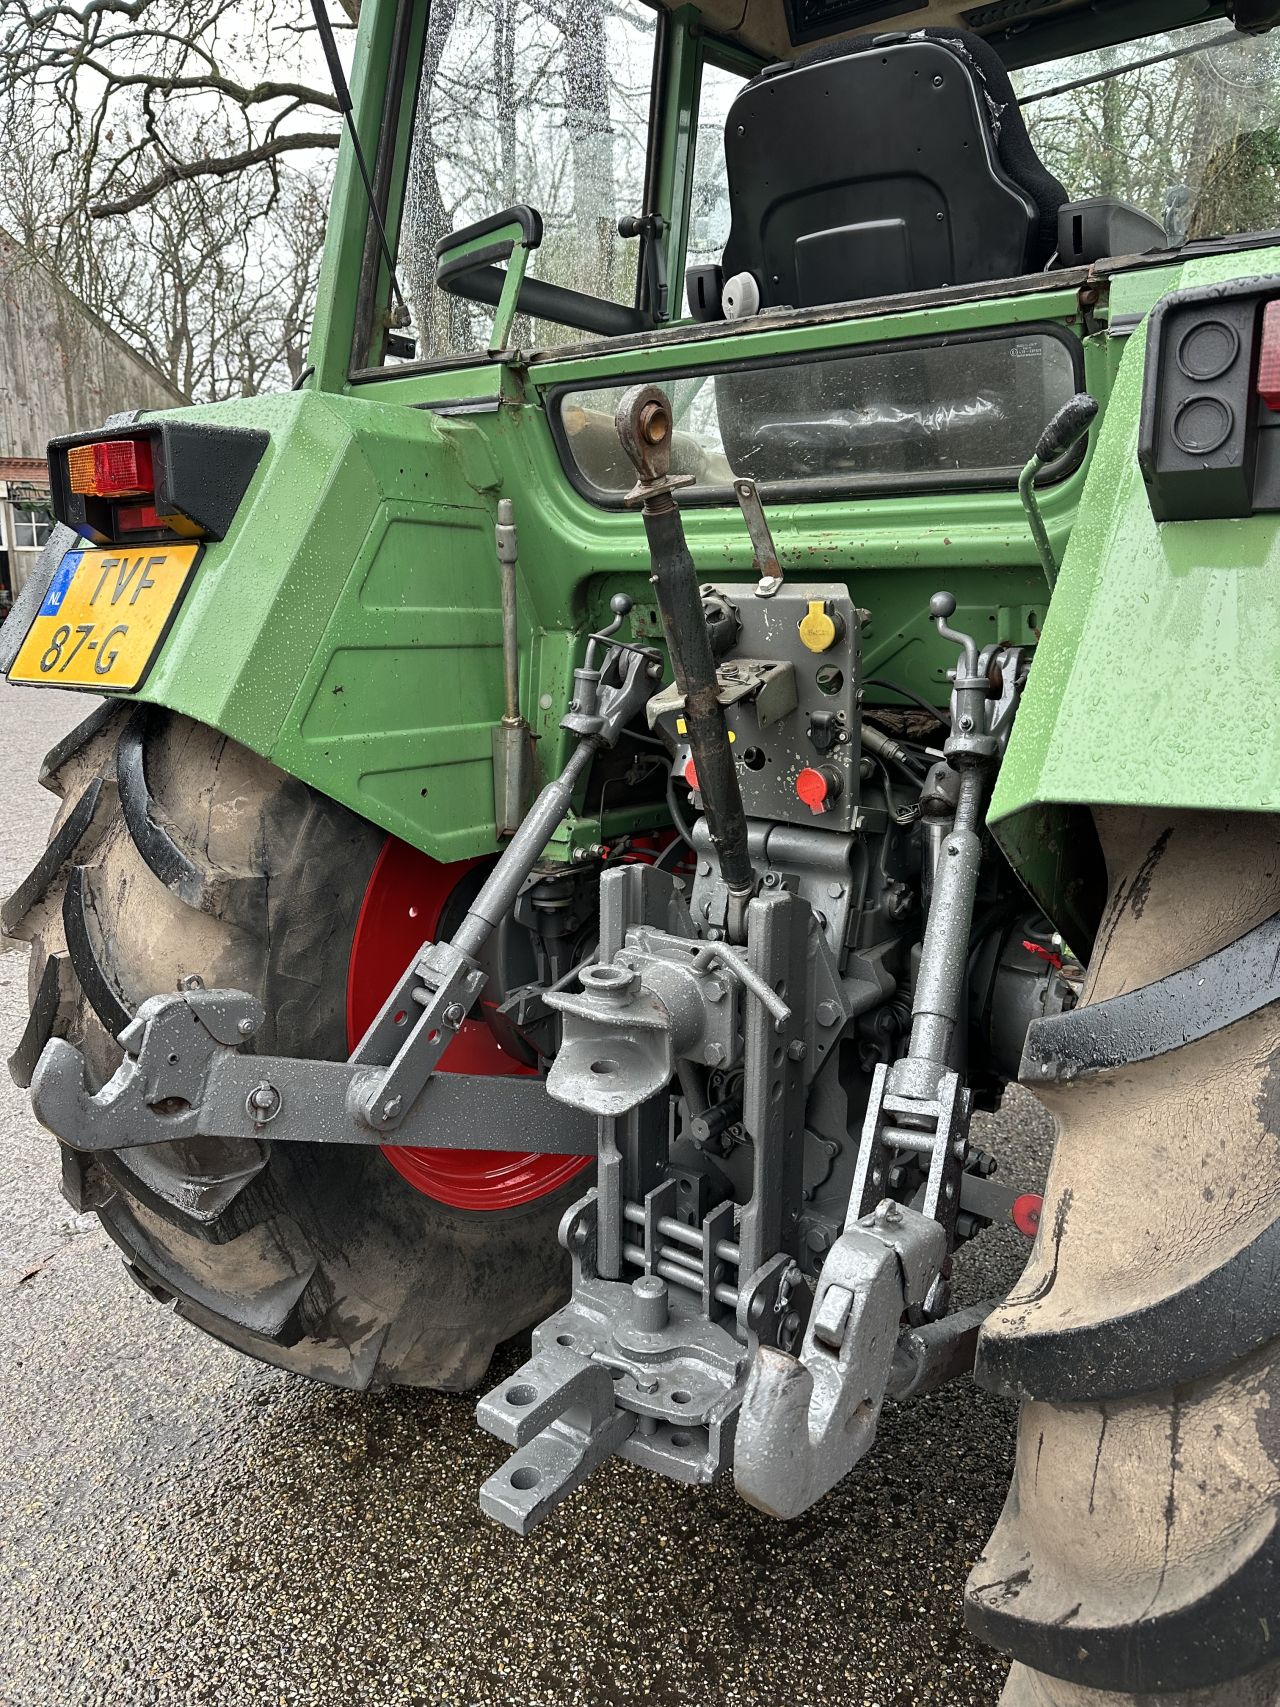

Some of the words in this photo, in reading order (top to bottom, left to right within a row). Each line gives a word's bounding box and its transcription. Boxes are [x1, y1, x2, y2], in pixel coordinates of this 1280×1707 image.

[47, 591, 61, 606] NL
[90, 556, 167, 606] TVF
[40, 624, 129, 675] 87-G
